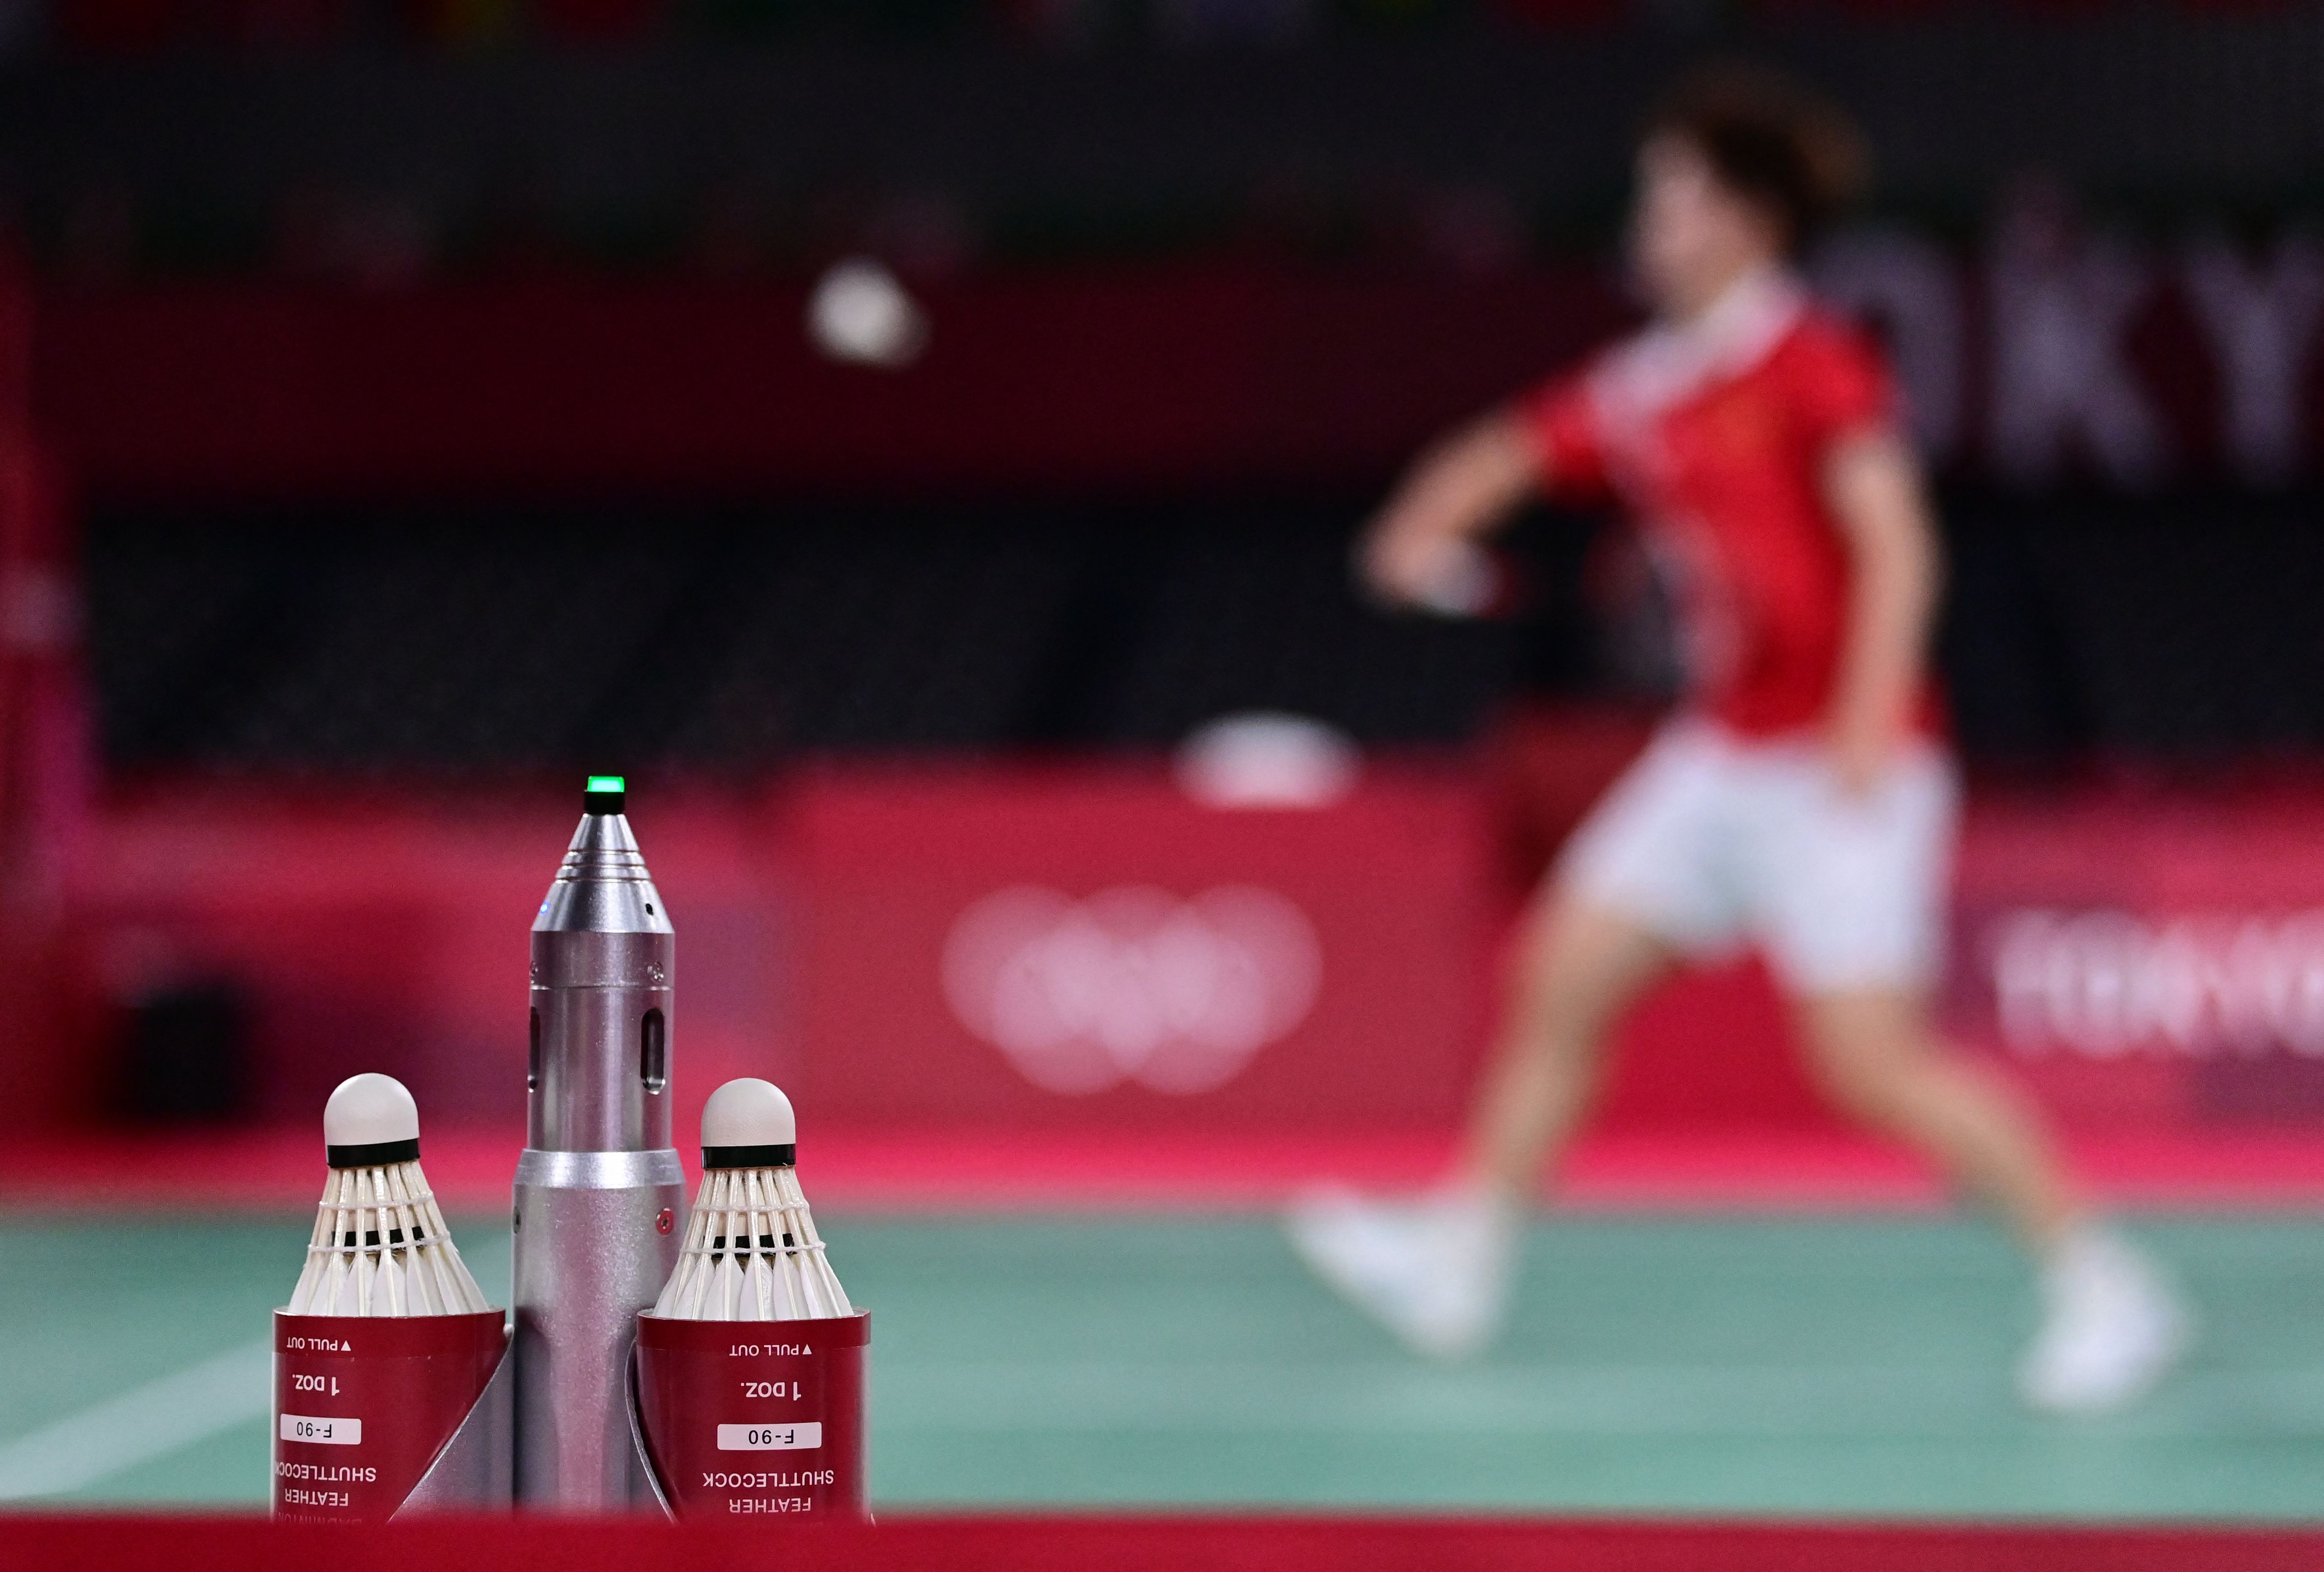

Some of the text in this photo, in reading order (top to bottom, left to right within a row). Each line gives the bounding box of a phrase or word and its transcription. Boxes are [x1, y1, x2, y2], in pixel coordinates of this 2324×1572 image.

[286, 1337, 338, 1351] PULL OUT
[729, 1344, 799, 1356] PULL OUT
[292, 1374, 340, 1396] 1 DOZ.
[741, 1382, 802, 1401] 1 DOZ.
[296, 1421, 332, 1438] F-90
[748, 1429, 794, 1445] F-90
[702, 1470, 834, 1488] SHUTTLECOCK
[285, 1488, 349, 1507] FEATHER
[729, 1497, 811, 1513] FEATHER
